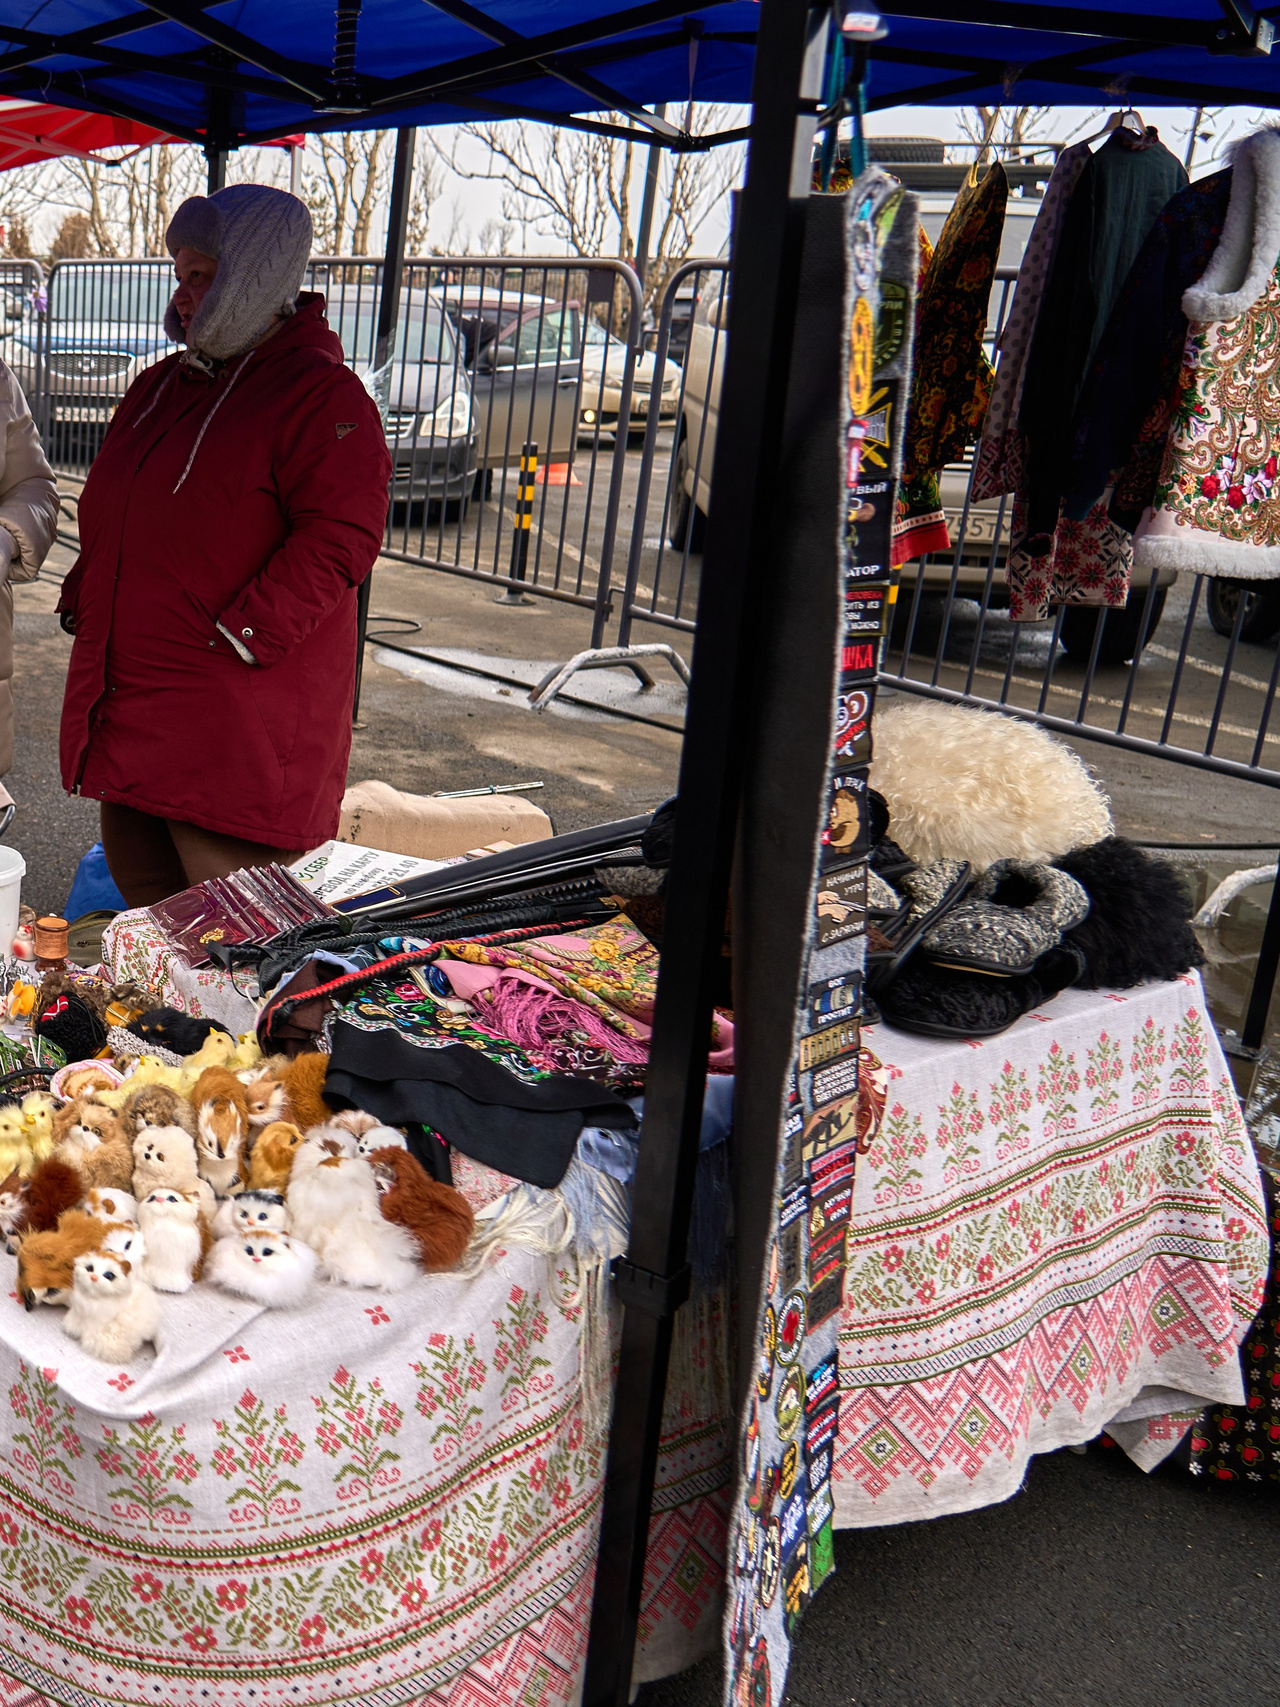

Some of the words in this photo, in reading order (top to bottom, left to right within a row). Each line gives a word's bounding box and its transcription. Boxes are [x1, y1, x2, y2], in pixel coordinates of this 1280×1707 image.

[304, 857, 329, 873] СБЕР
[338, 867, 359, 879] НА
[350, 851, 380, 869] КАРТУ
[399, 859, 419, 869] 40
[826, 867, 865, 887] НАЧИНАЙ
[844, 882, 865, 896] УТРО
[817, 1005, 853, 1024] ПРОСТИТ
